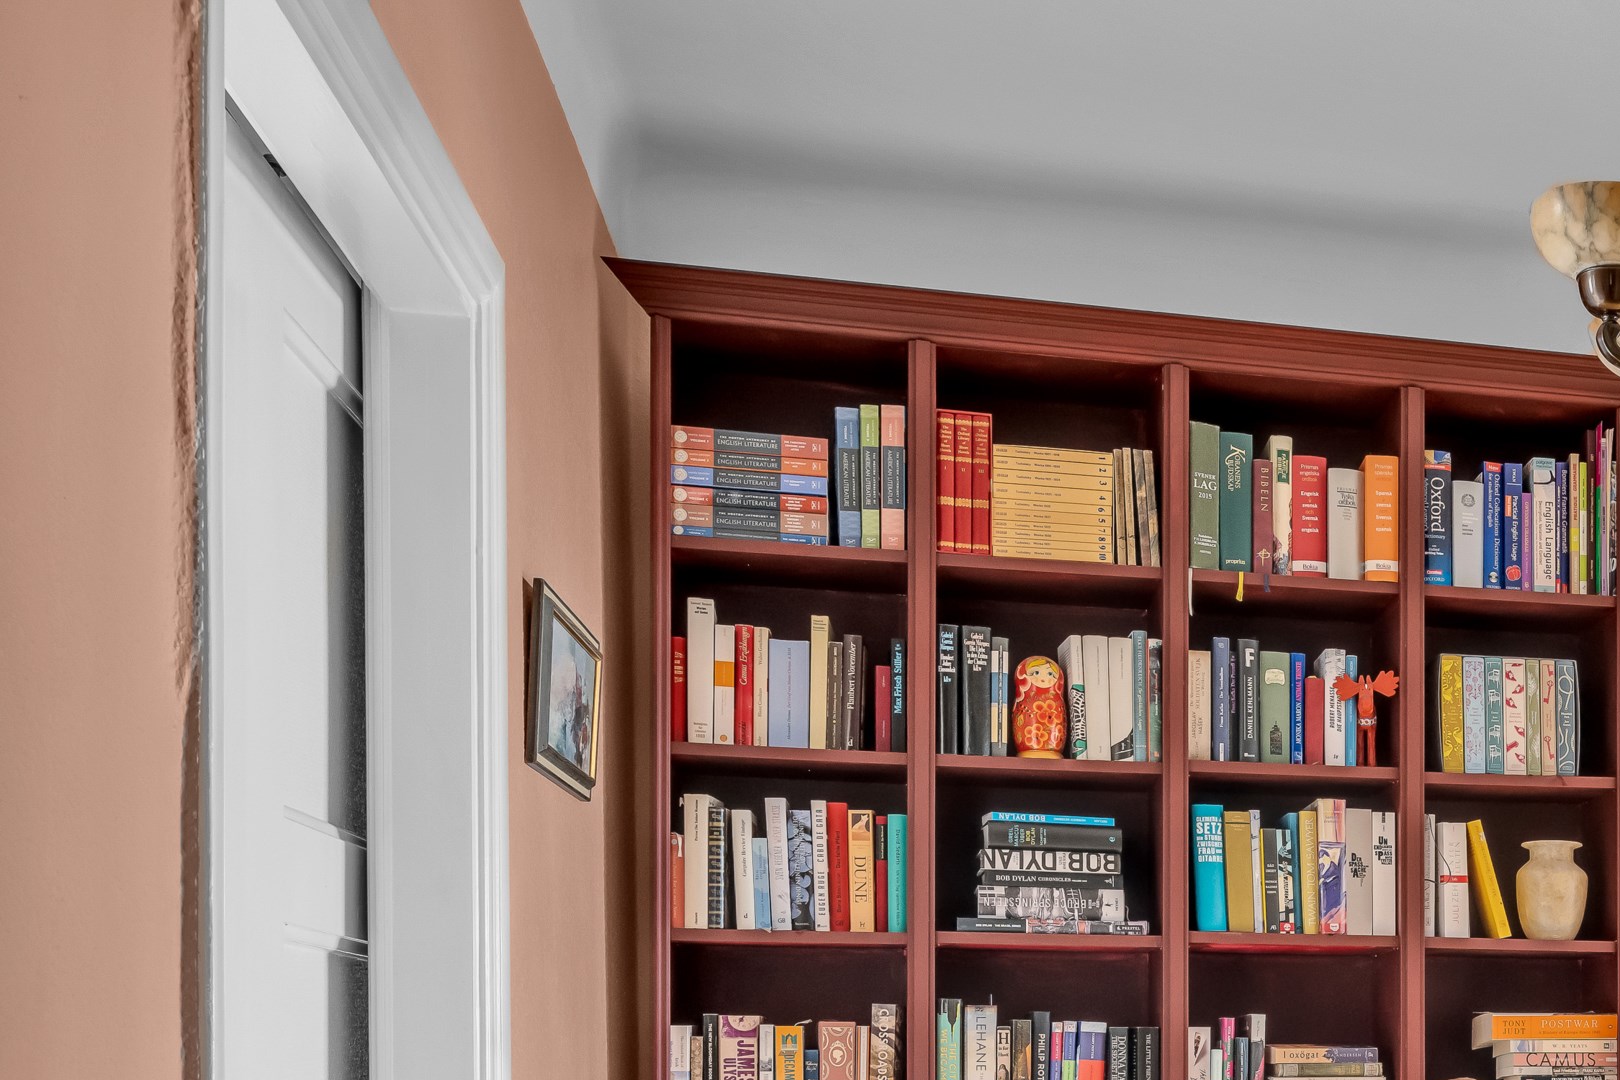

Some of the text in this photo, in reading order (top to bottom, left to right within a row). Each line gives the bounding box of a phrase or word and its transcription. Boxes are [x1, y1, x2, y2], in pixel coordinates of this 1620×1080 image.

[744, 440, 778, 449] LITERATURE
[744, 460, 778, 468] LITERATURE
[1224, 444, 1246, 489] KORANENS
[1194, 471, 1216, 479] SVENSK
[743, 479, 778, 487] LITERATURE
[1193, 478, 1217, 491] LAG
[1260, 467, 1269, 512] BIBELN
[1198, 491, 1213, 500] 2015
[742, 498, 777, 507] LITERATURE
[1430, 477, 1445, 533] Oxford
[742, 520, 777, 528] LITERATURE
[1543, 501, 1554, 580] English Language
[846, 642, 856, 710] Flaubert November
[894, 652, 902, 714] Max Frisch Stiller
[998, 813, 1026, 821] DYLAN
[1196, 822, 1222, 834] SETZ
[816, 831, 823, 840] DE
[981, 849, 1116, 873] BOB DYLAN
[1304, 818, 1316, 925] TWAIN TOM SAWYER
[854, 856, 868, 903] DUNE
[984, 897, 1086, 908] BRUCE SPRINGSTEEN
[1541, 1019, 1598, 1028] POSTWAR
[941, 1028, 948, 1044] WE
[998, 1032, 1009, 1044] H
[976, 1016, 986, 1071] LEHANE
[1118, 1035, 1126, 1068] DONNA
[1526, 1052, 1596, 1067] CAMUS
